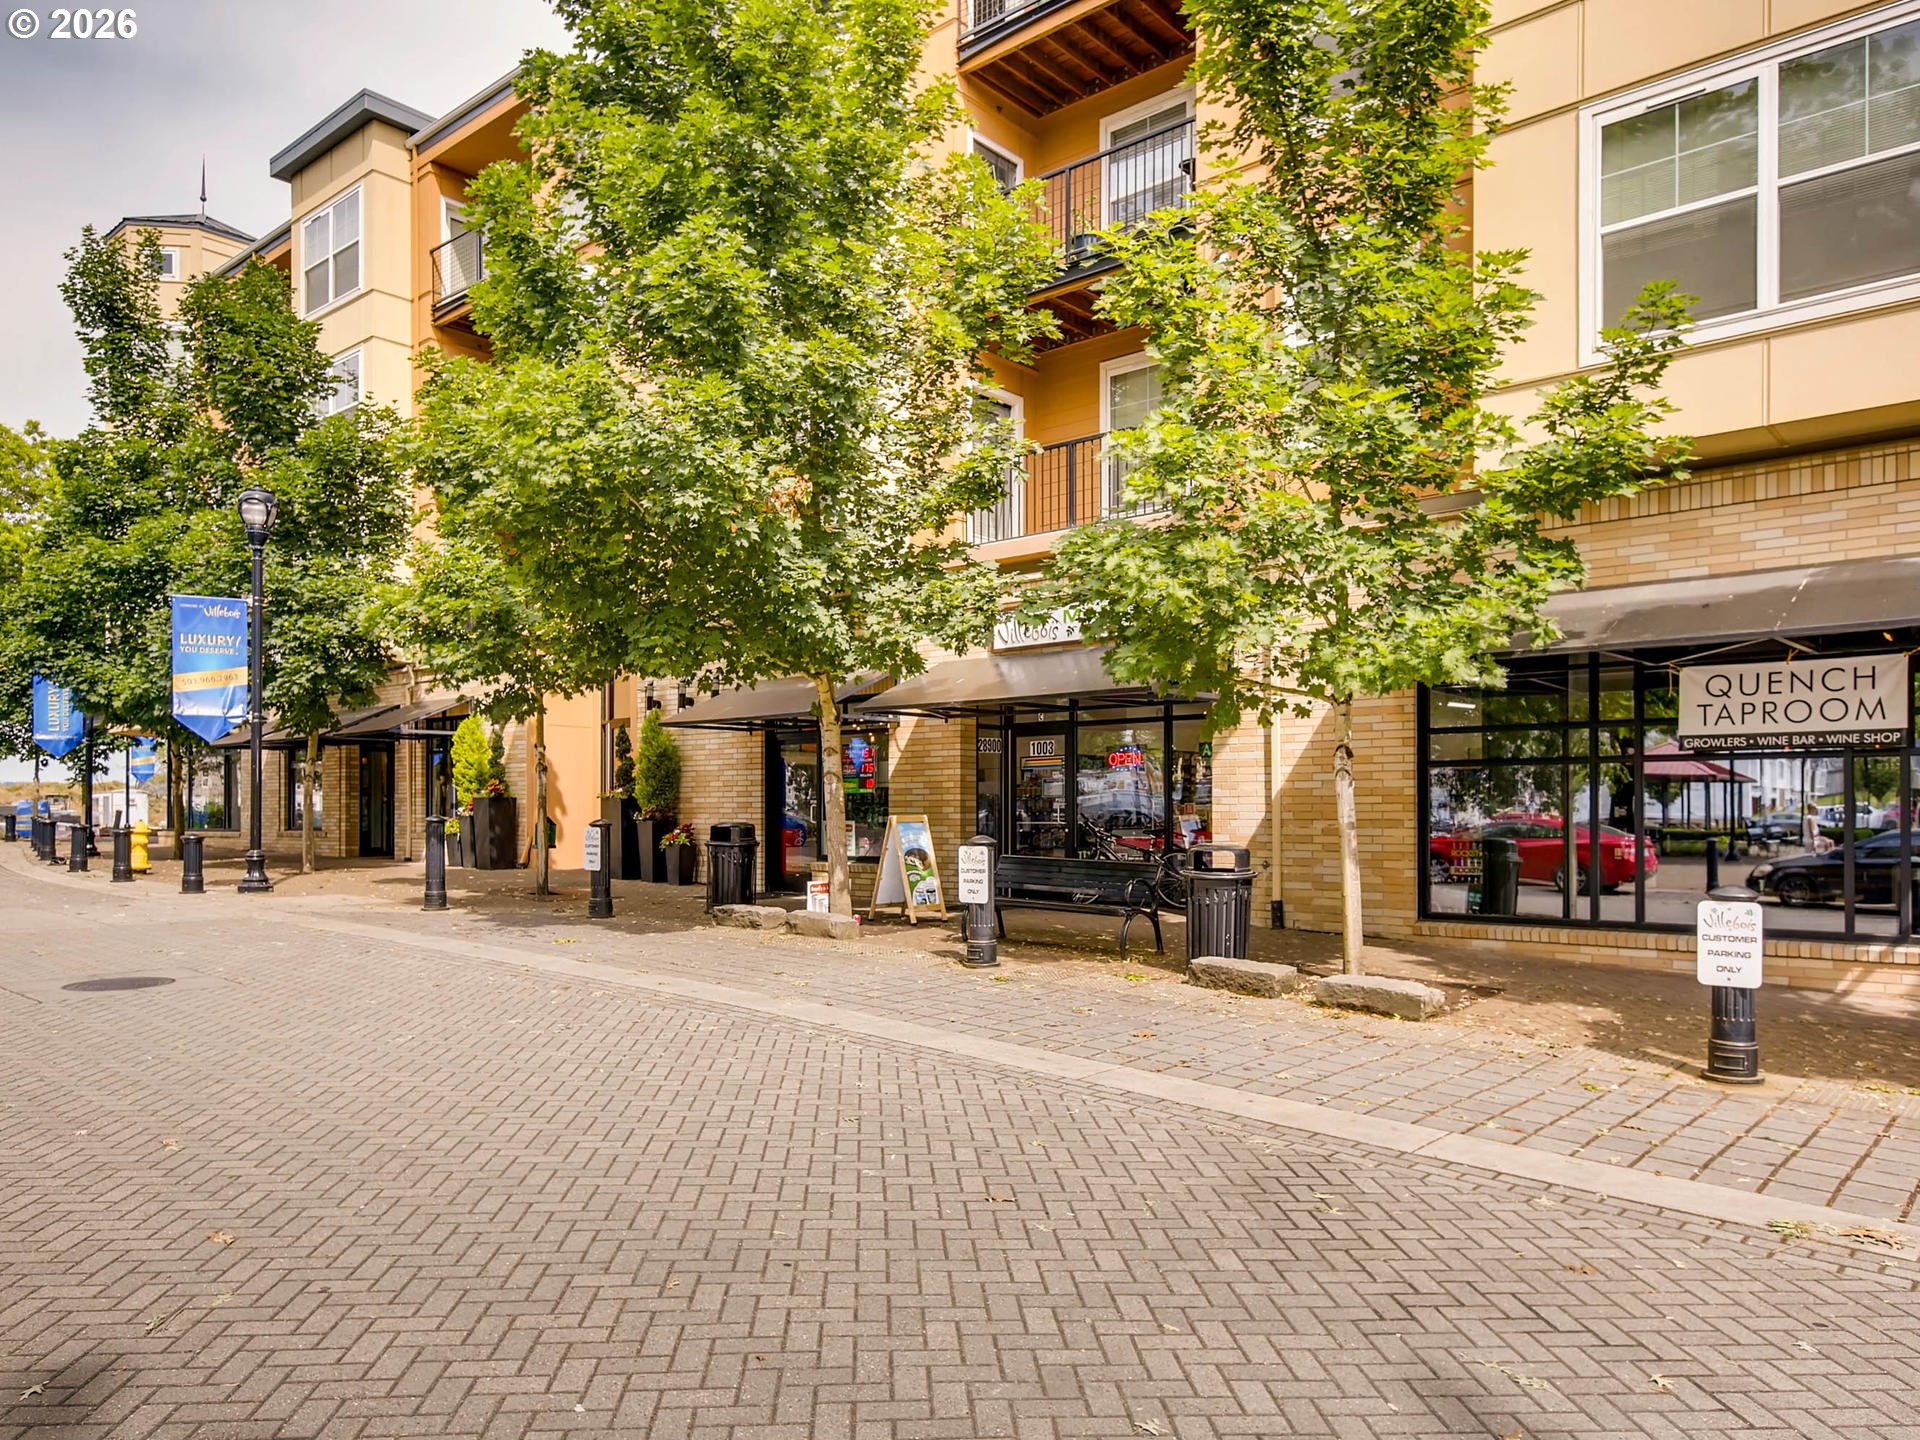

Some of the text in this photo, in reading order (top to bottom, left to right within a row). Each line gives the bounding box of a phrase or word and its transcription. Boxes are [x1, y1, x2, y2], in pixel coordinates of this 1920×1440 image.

[1705, 665, 1877, 699] QUENCH
[47, 686, 60, 732] LUXURY
[1697, 697, 1886, 726] TAPROOM
[978, 738, 1001, 753] 28900
[1684, 731, 1901, 749] GROWLERS WINE BAR WINE SHOP
[1031, 741, 1054, 755] 1003
[1108, 752, 1143, 766] OPEN
[1703, 911, 1757, 931] Villebois
[1701, 933, 1758, 943] CUSTOMER
[1707, 949, 1752, 959] PARKING
[1716, 965, 1742, 973] ONLY
